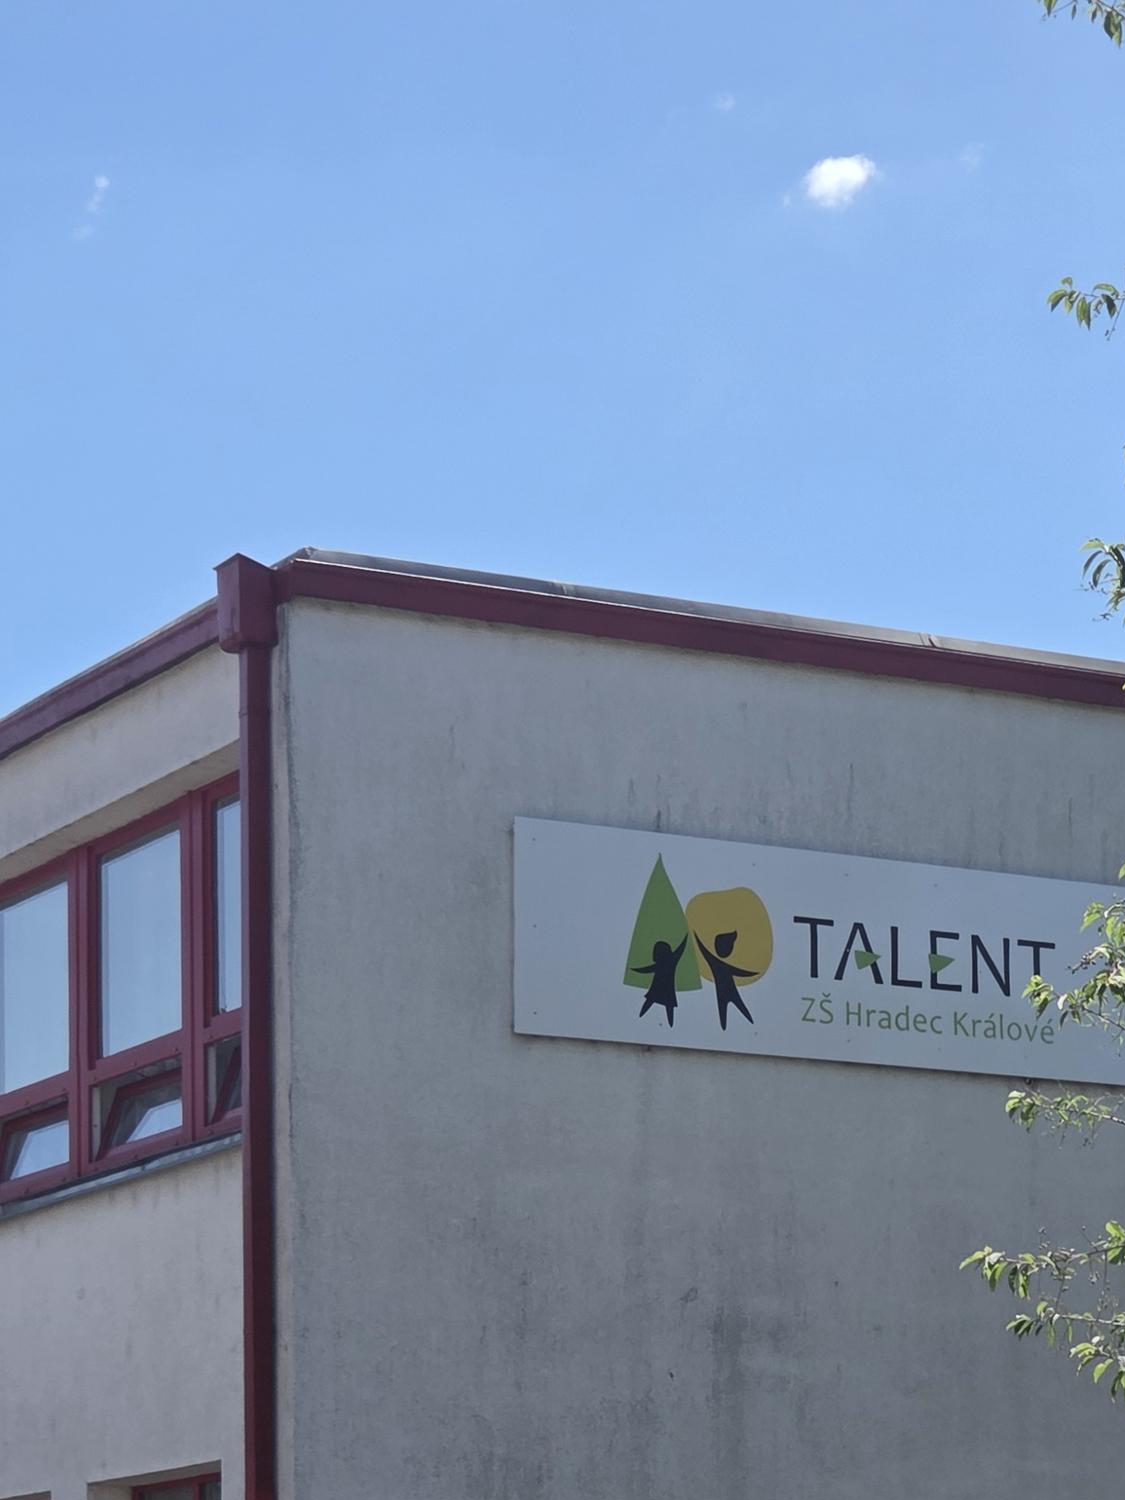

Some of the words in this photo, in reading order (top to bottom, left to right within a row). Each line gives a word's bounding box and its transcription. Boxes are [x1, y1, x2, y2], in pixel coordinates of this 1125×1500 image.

[793, 915, 1056, 997] TALENT
[801, 992, 835, 1025] ZŠ
[845, 1001, 943, 1035] Hradec
[953, 1011, 1055, 1045] Králové
